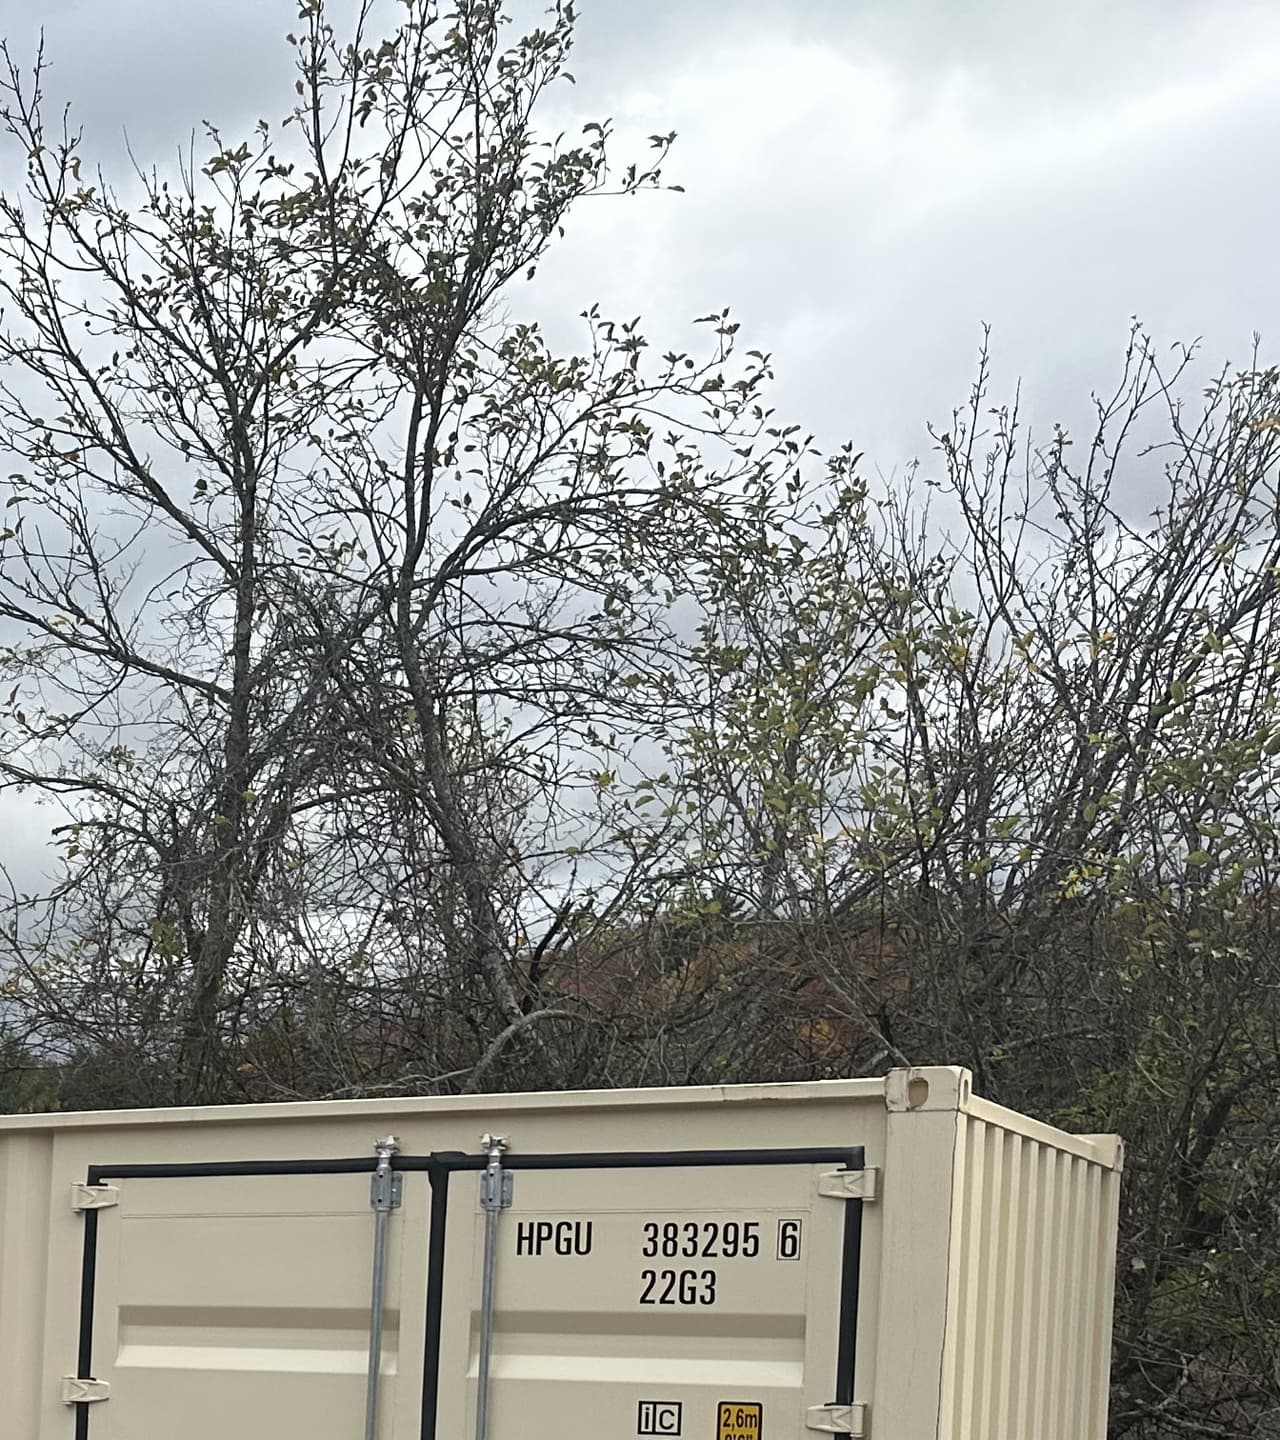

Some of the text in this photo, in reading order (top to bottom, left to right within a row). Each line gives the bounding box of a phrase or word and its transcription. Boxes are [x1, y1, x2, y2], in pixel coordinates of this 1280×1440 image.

[516, 1221, 798, 1257] HPGU 383295 6
[639, 1270, 716, 1304] 22G3
[723, 1408, 757, 1430] 2,6m
